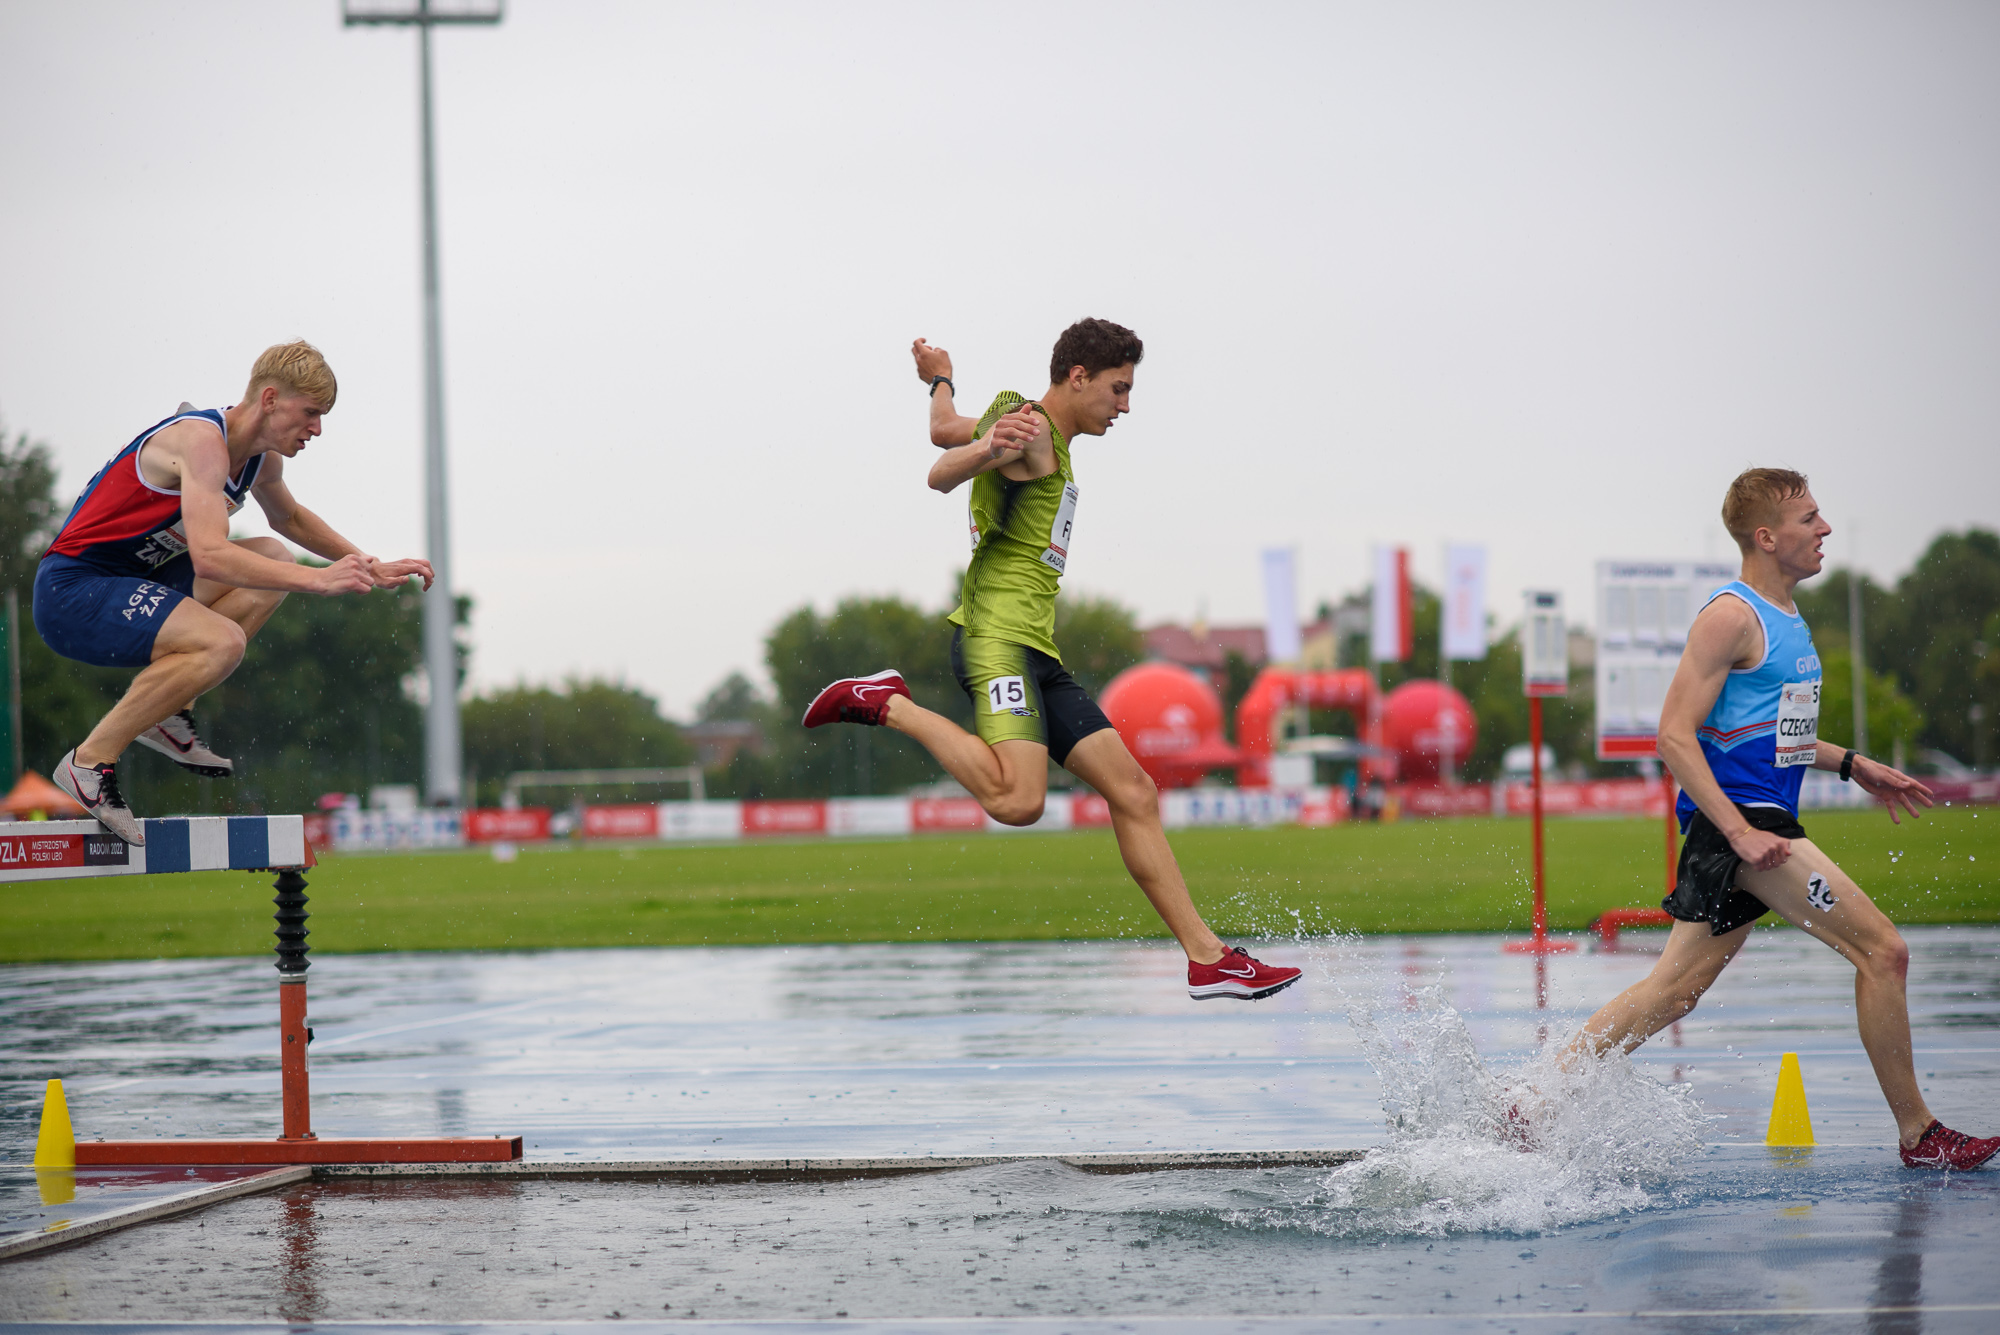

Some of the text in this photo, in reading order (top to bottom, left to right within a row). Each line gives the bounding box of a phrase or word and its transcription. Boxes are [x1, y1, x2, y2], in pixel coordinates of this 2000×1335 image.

[1047, 553, 1066, 568] RADO
[122, 580, 157, 620] AGR
[991, 681, 1023, 705] 15
[32, 840, 70, 850] MISTRZOSTWA
[89, 842, 123, 855] RADOM 2022
[32, 851, 63, 861] POLSKI U20
